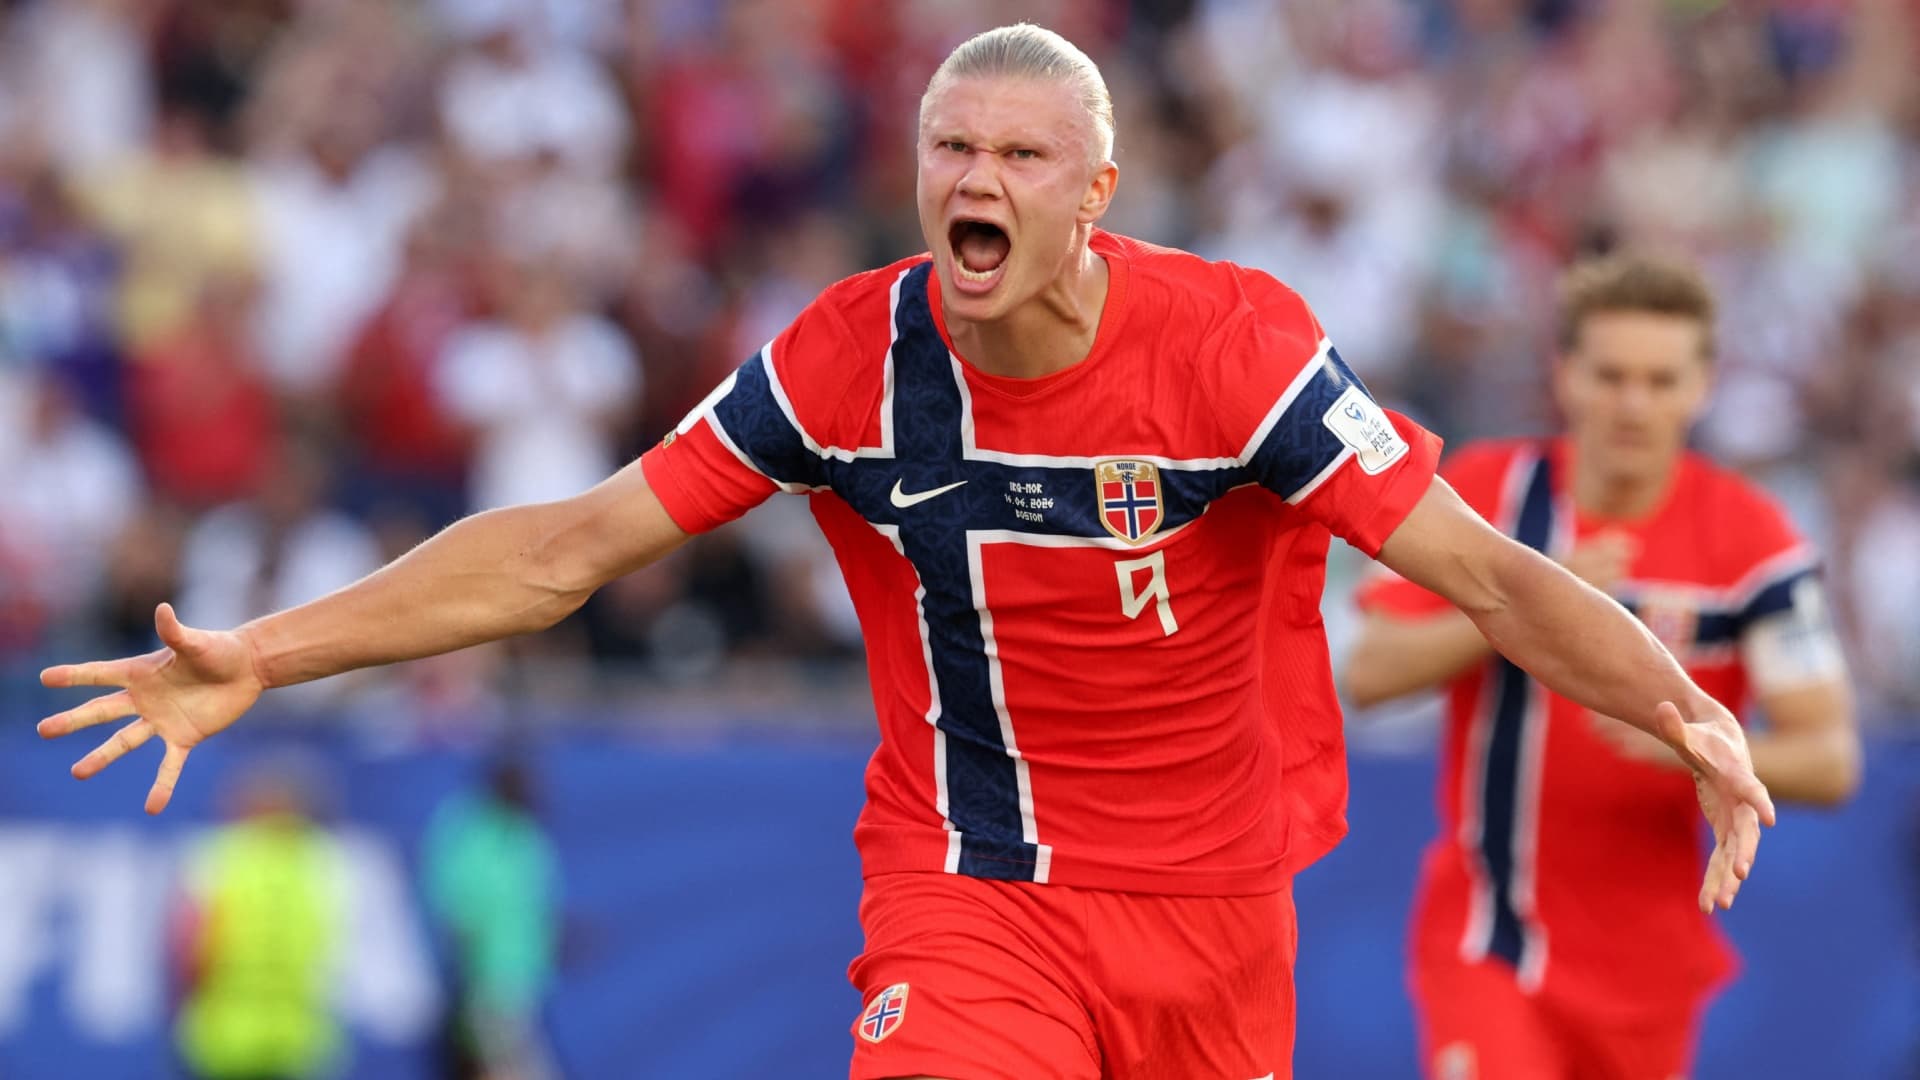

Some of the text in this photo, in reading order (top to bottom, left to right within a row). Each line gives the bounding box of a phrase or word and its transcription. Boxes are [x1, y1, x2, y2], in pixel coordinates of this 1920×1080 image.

[1116, 462, 1136, 471] NORGE
[1015, 509, 1043, 523] BOSTON
[1113, 549, 1179, 637] 9
